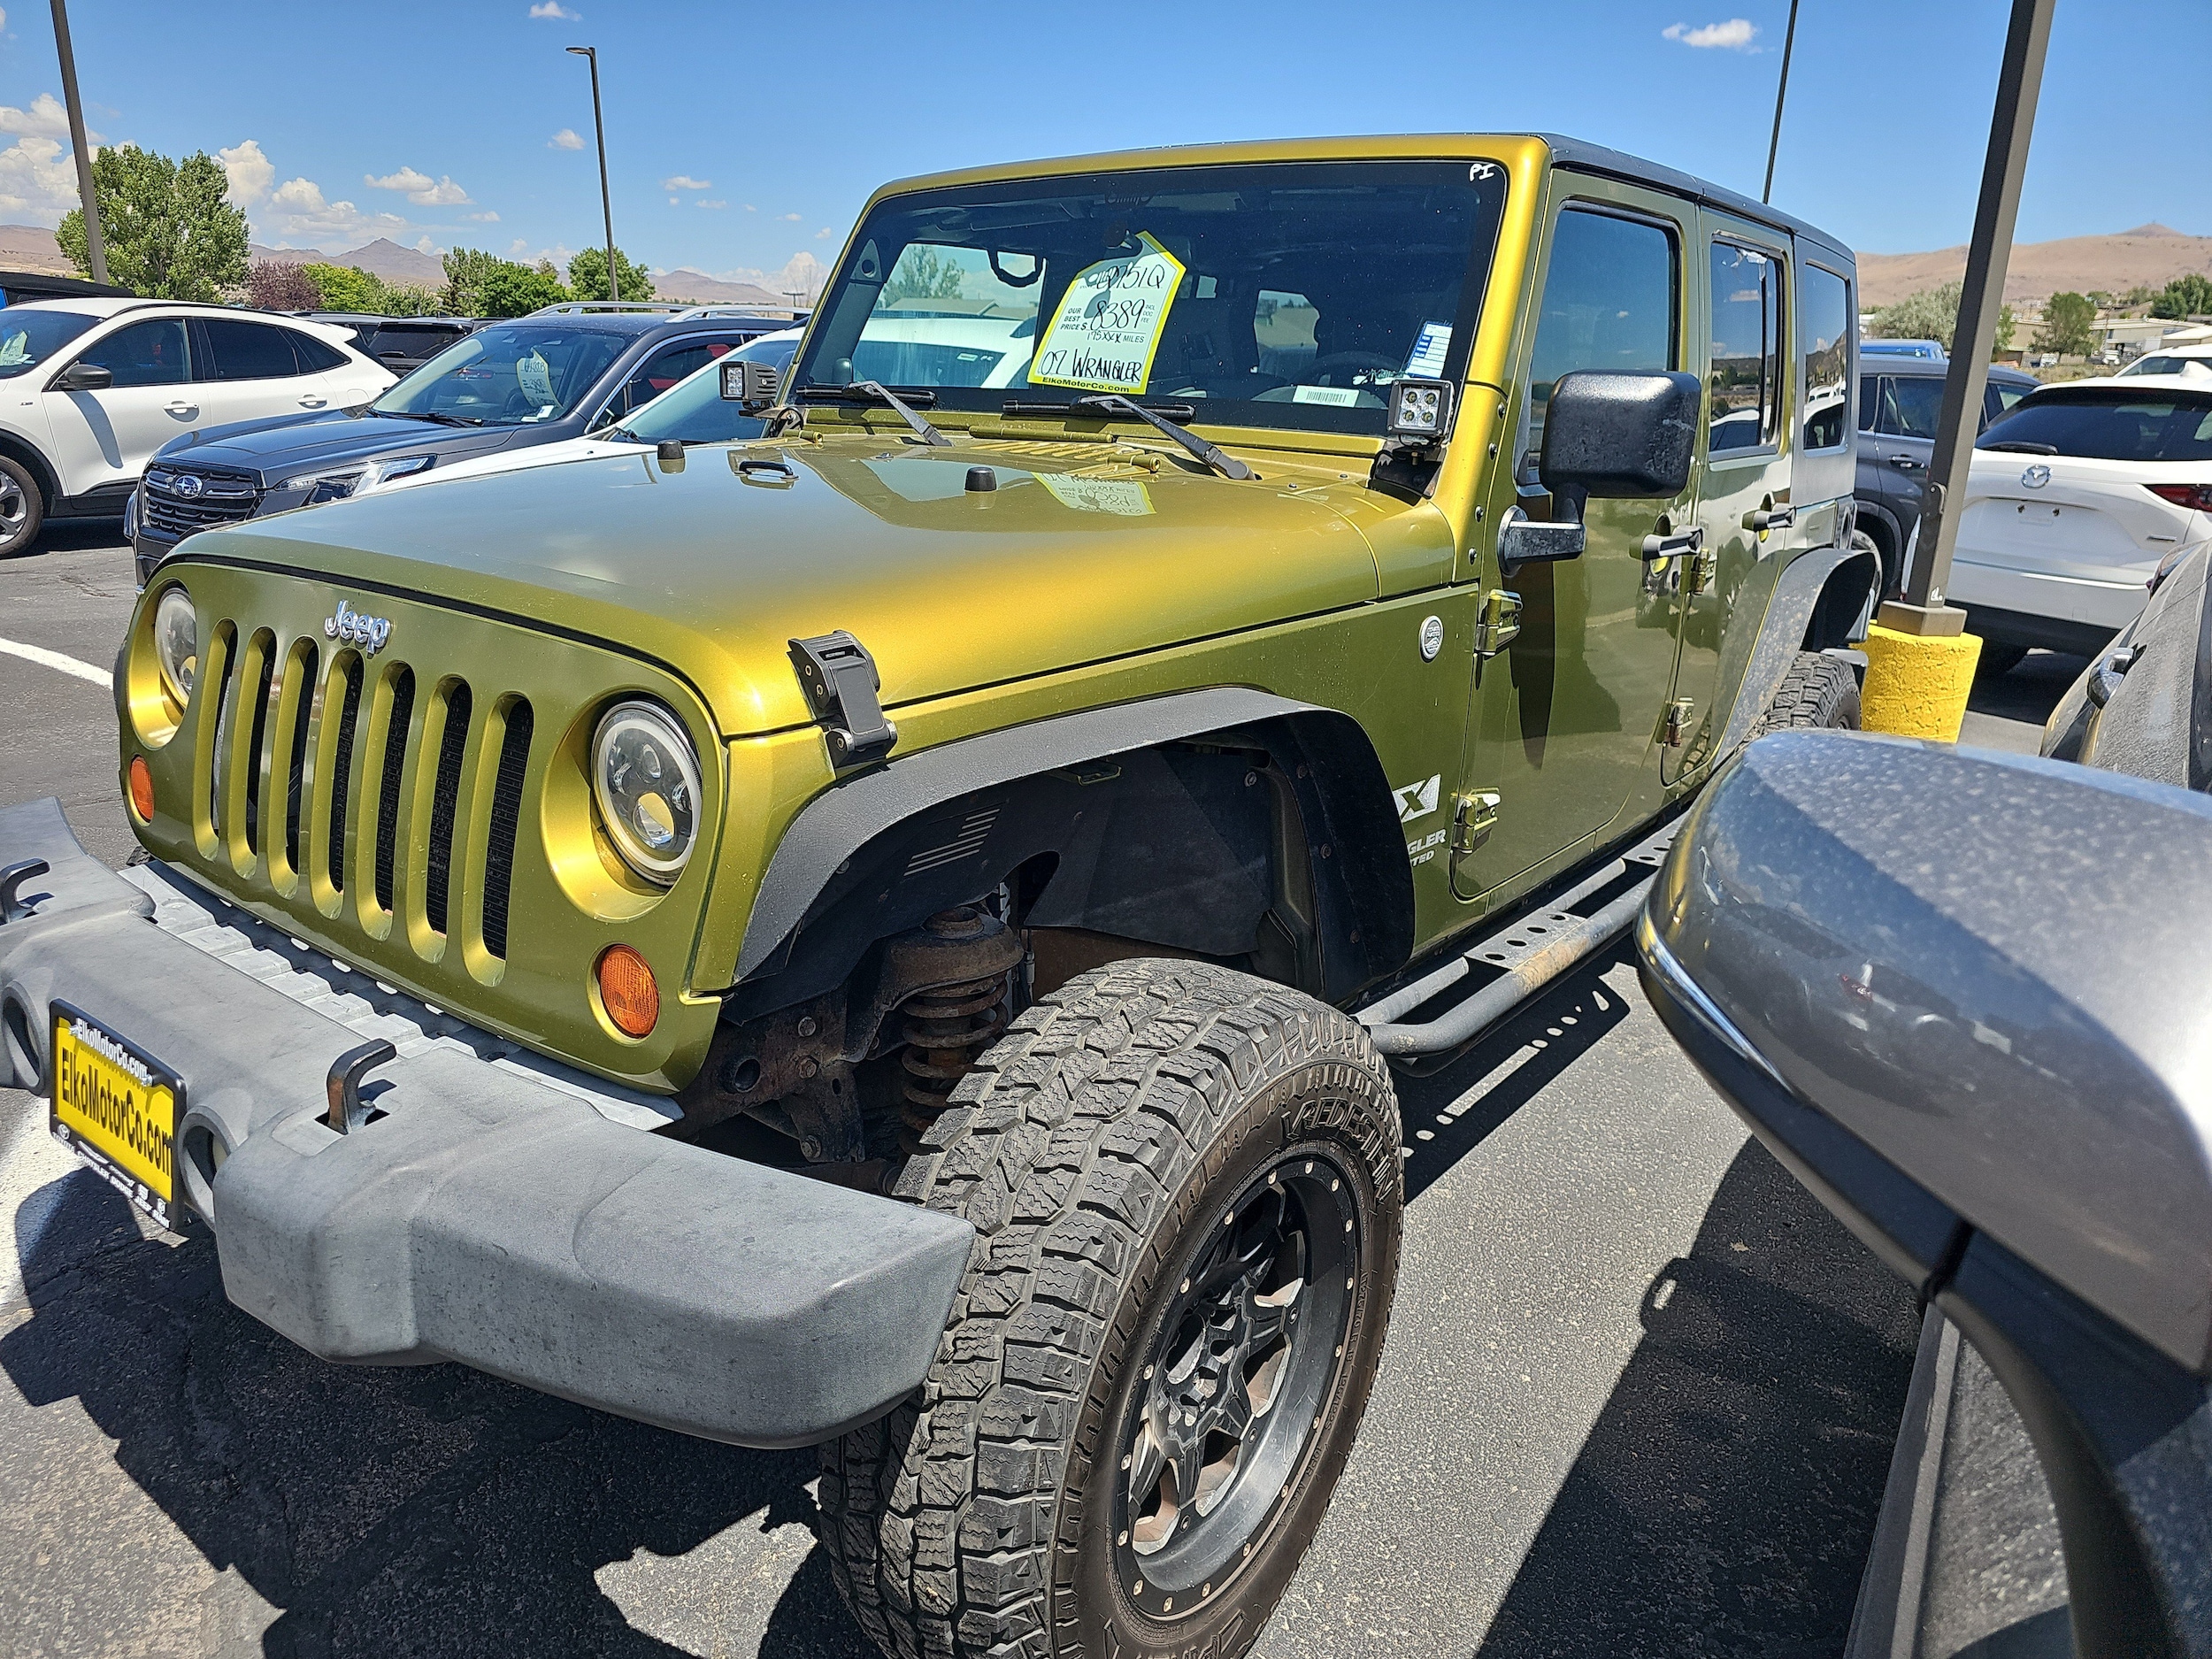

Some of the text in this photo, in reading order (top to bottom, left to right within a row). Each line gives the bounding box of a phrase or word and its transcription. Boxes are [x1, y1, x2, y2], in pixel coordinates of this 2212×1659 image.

[1469, 163, 1495, 182] PI
[1090, 298, 1145, 331] 8389
[1123, 334, 1145, 343] MILES
[1041, 346, 1142, 381] 07 WRANGLER
[1041, 376, 1131, 393] ElkoMotorCo.com
[324, 599, 391, 654] Jeep
[1407, 828, 1447, 855] GLER
[76, 1018, 149, 1081] ElkoMotorCo.com
[62, 1047, 173, 1178] ElkoMotorCo.com
